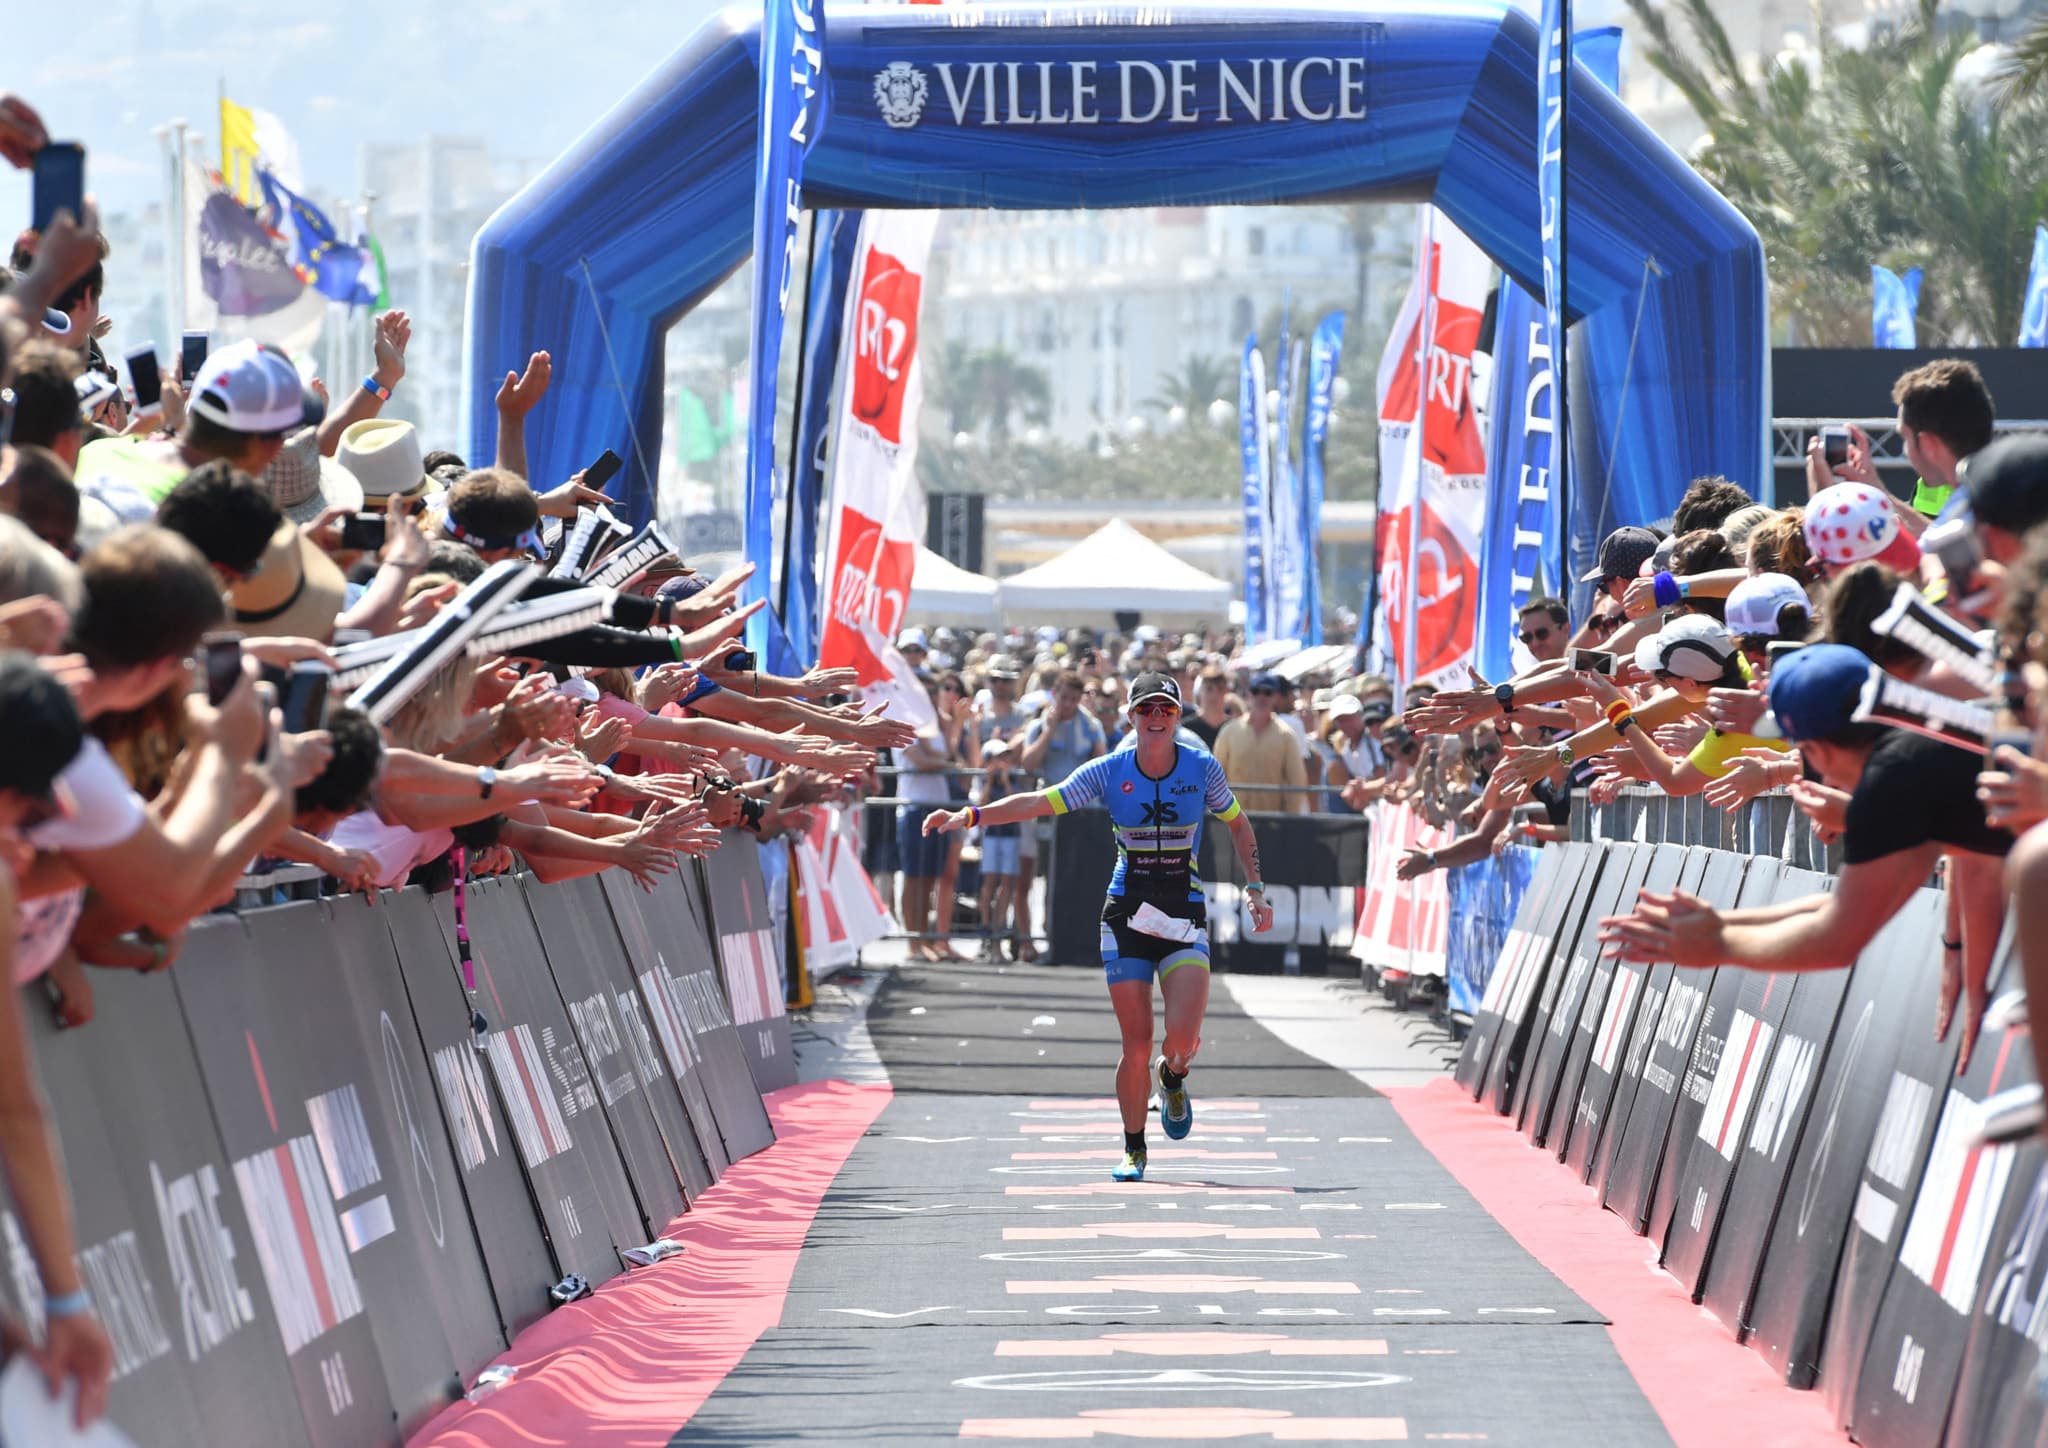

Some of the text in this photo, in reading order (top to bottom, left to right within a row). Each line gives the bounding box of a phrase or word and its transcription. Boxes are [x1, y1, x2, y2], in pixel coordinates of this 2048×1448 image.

[934, 57, 1366, 126] VILLE DE NICE
[848, 1201, 1448, 1212] V-Class
[817, 1304, 1558, 1319] V-Class
